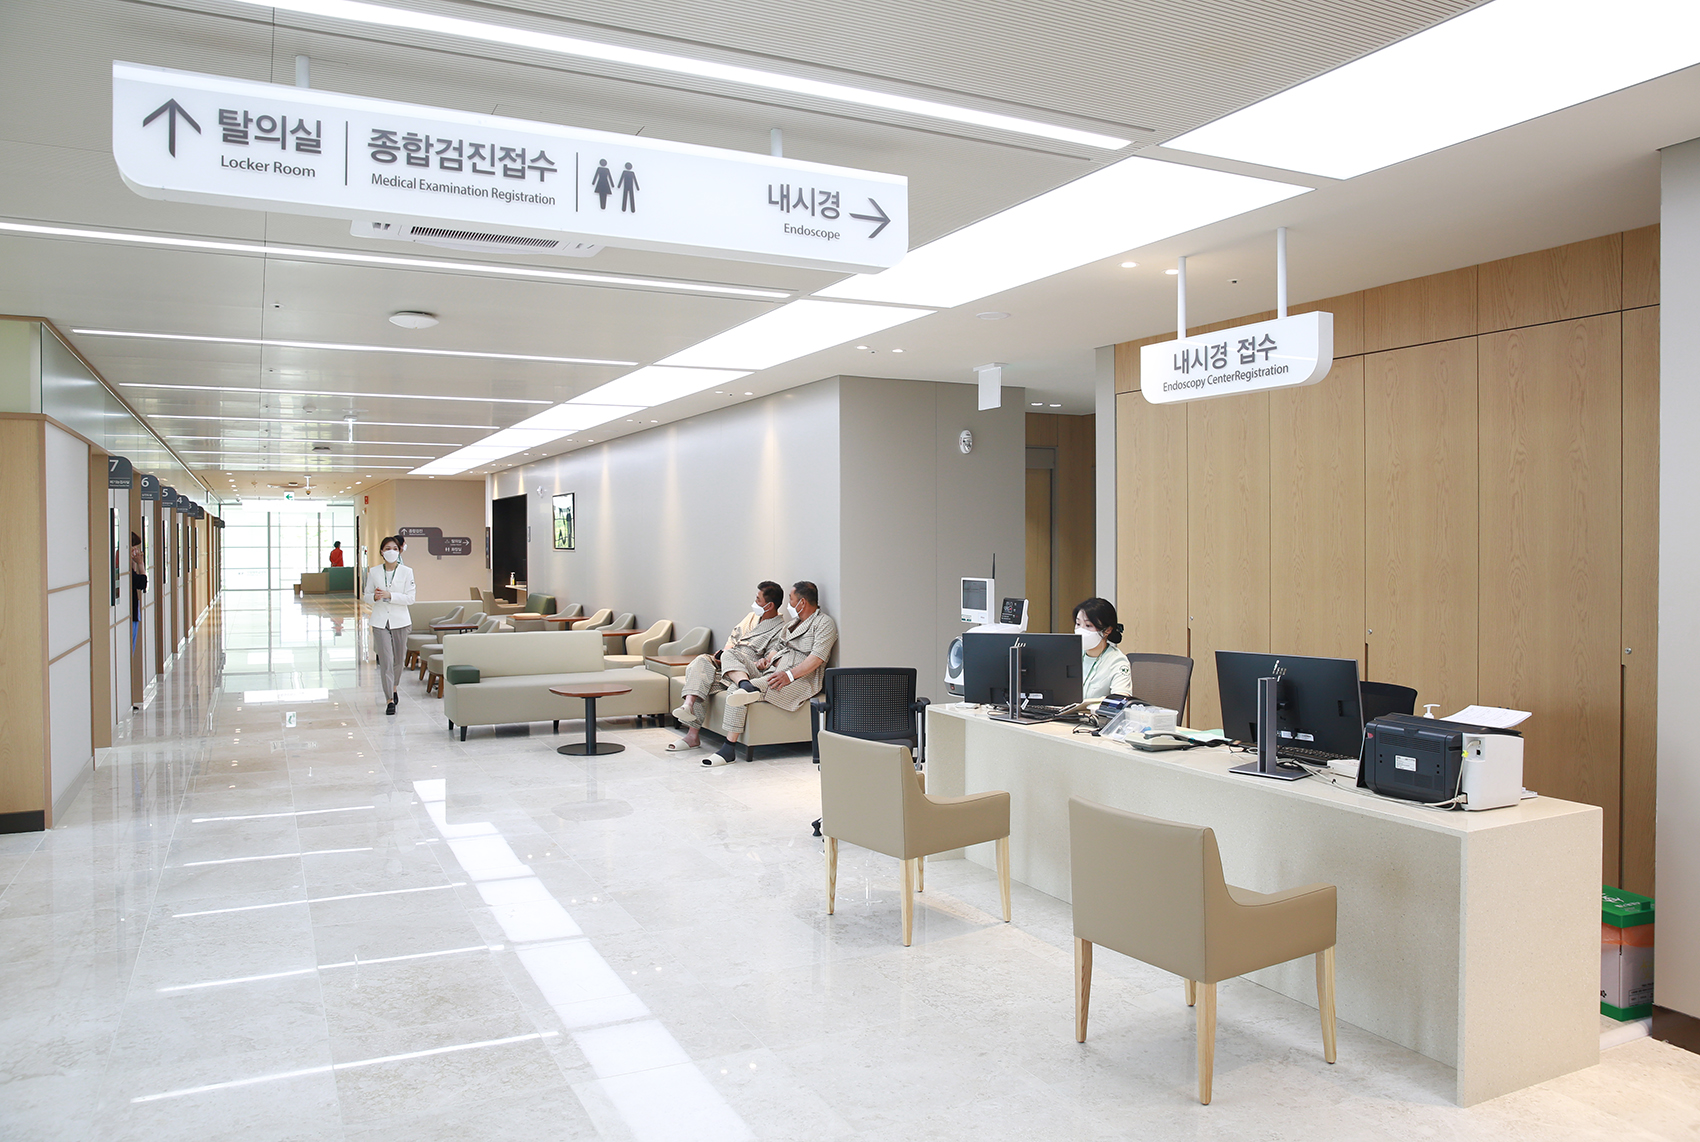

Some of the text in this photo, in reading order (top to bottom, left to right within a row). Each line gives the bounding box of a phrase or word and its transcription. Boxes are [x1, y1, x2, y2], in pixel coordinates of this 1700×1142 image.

[217, 108, 323, 156] 탈의실
[220, 154, 317, 179] Locker Room
[367, 127, 558, 183] 종합검진접수
[370, 172, 557, 207] Medical Examination Registration
[768, 184, 840, 220] 내시경
[784, 223, 840, 241] Endoscope
[1174, 333, 1277, 374] 내시경 접수
[1162, 376, 1207, 393] Endoscopy
[109, 459, 119, 472] 7
[141, 477, 150, 487] 6
[162, 488, 169, 497] 5
